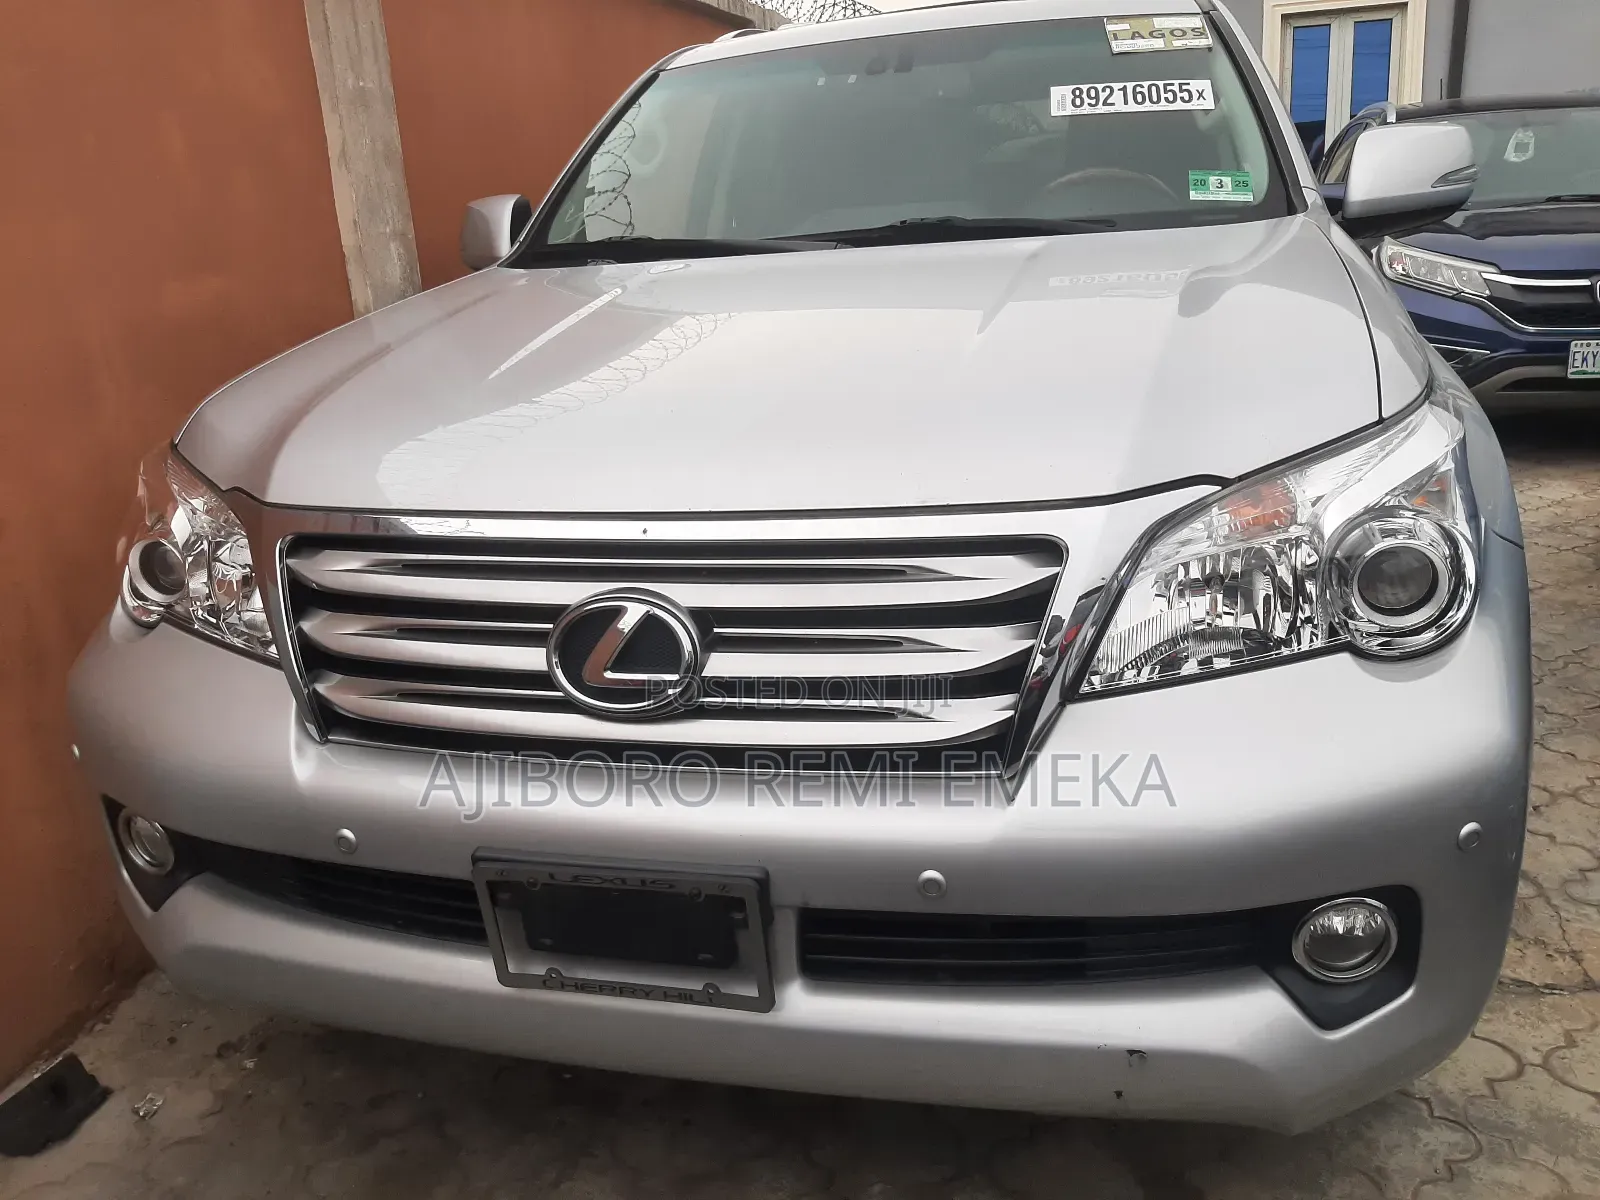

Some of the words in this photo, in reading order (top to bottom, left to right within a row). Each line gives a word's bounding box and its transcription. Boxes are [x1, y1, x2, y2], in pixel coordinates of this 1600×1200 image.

[1111, 27, 1206, 41] LAGOS
[1192, 178, 1207, 187] 20
[1213, 178, 1225, 189] 3
[1234, 180, 1249, 188] 25
[548, 871, 676, 889] LEXUS
[542, 978, 656, 998] CHERRY
